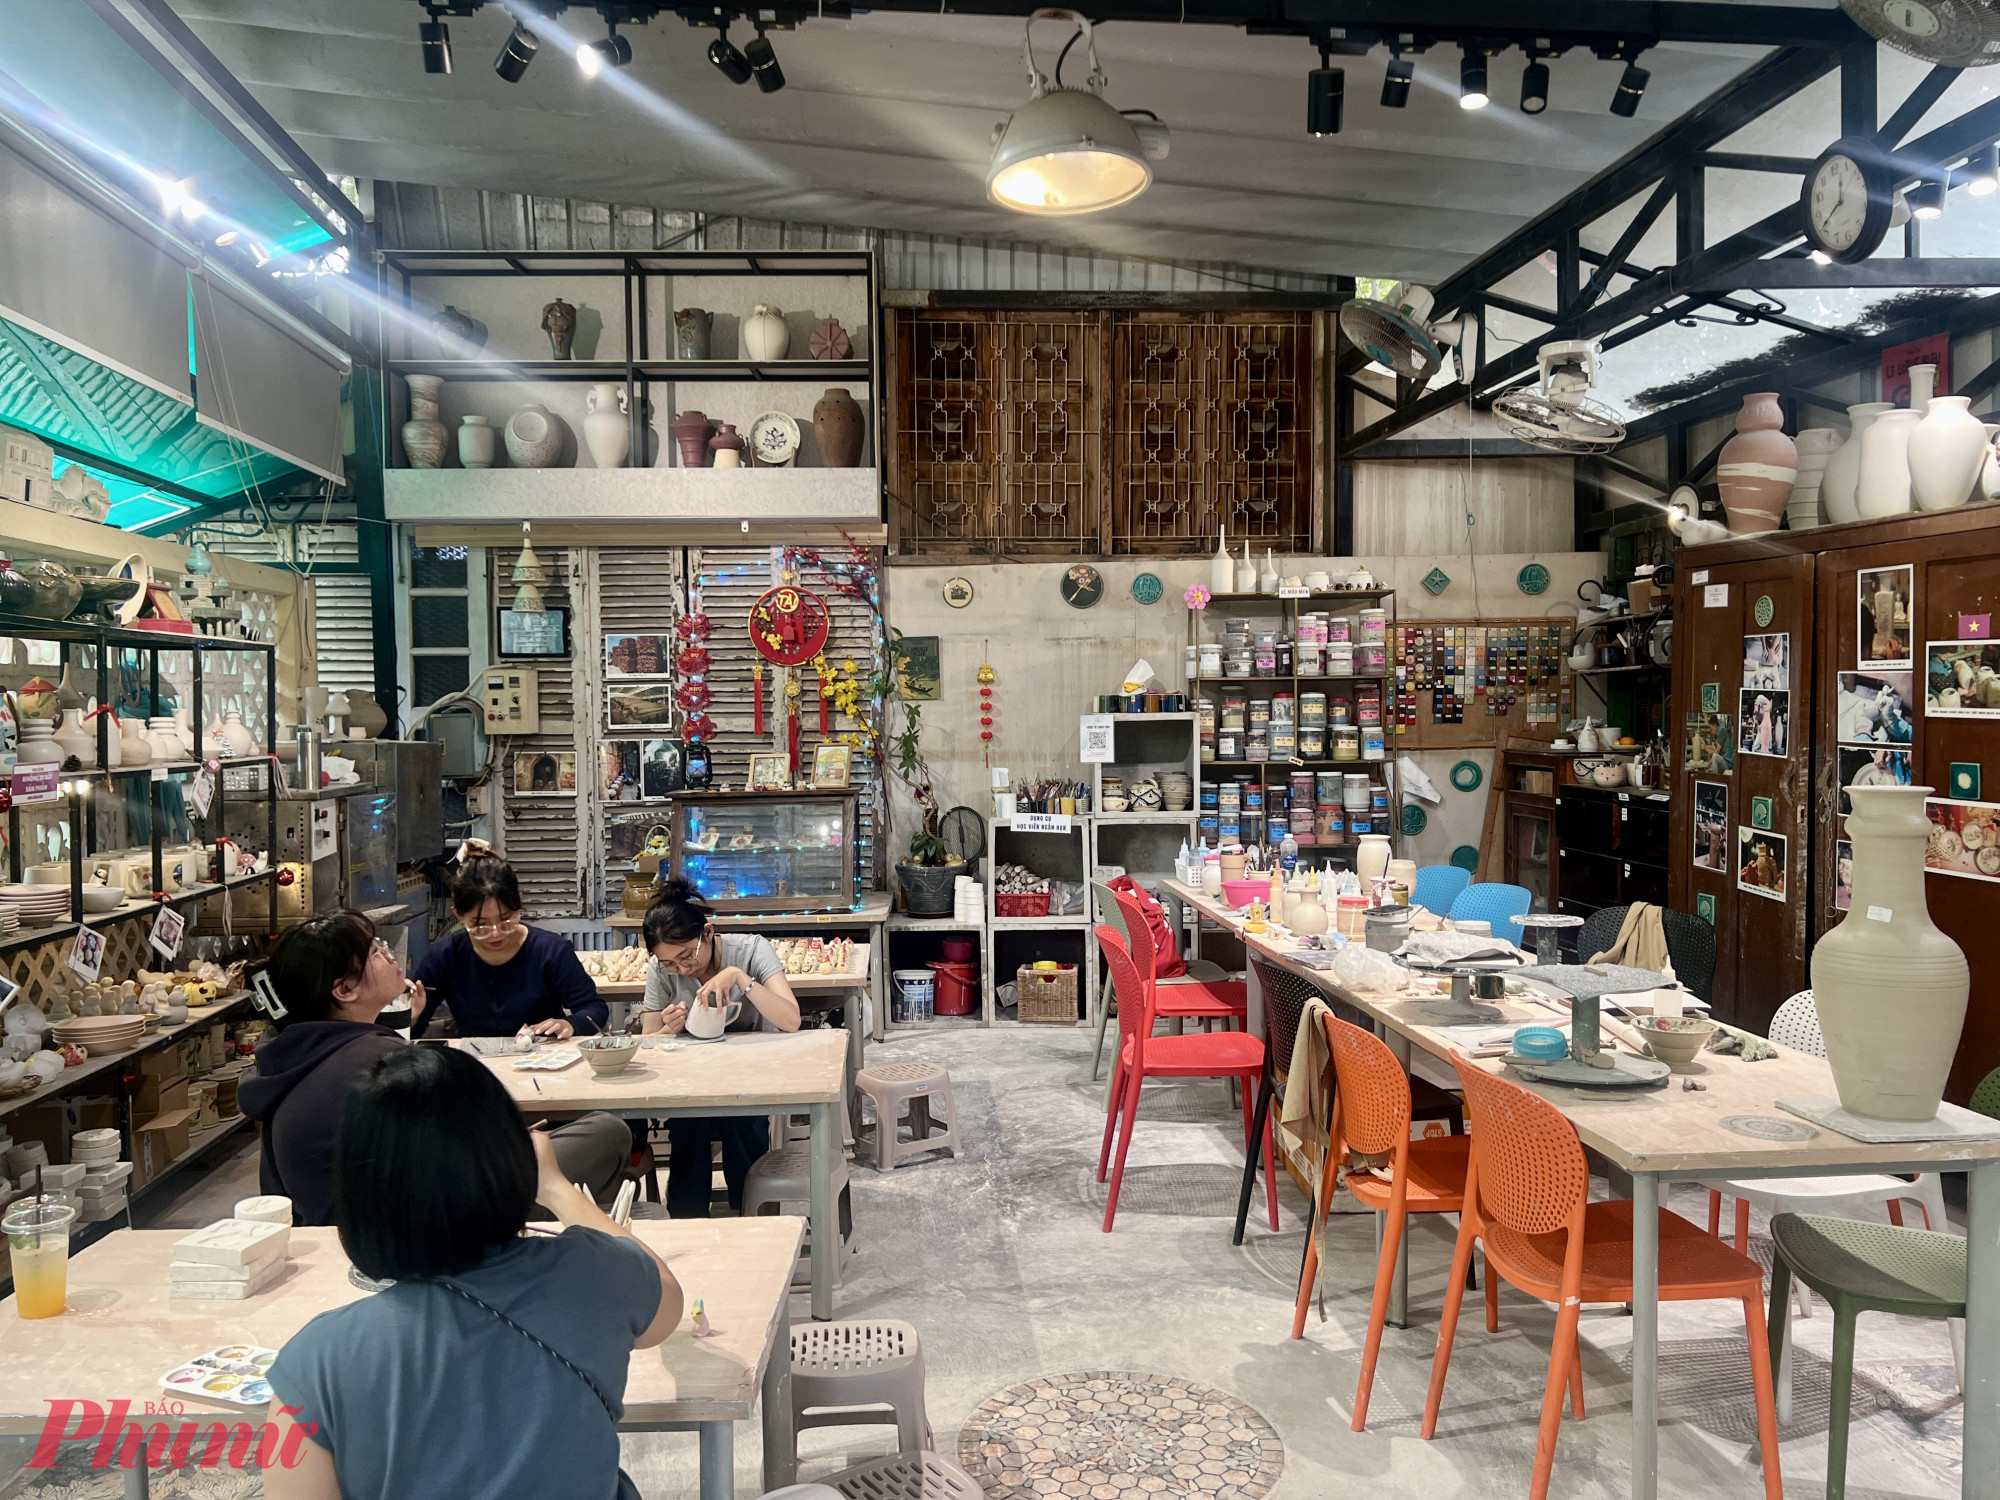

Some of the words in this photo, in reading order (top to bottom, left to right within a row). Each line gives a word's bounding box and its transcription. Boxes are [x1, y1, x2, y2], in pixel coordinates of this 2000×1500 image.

[1831, 162, 1838, 175] 12
[1821, 176, 1827, 187] 11
[1816, 192, 1823, 204] 10
